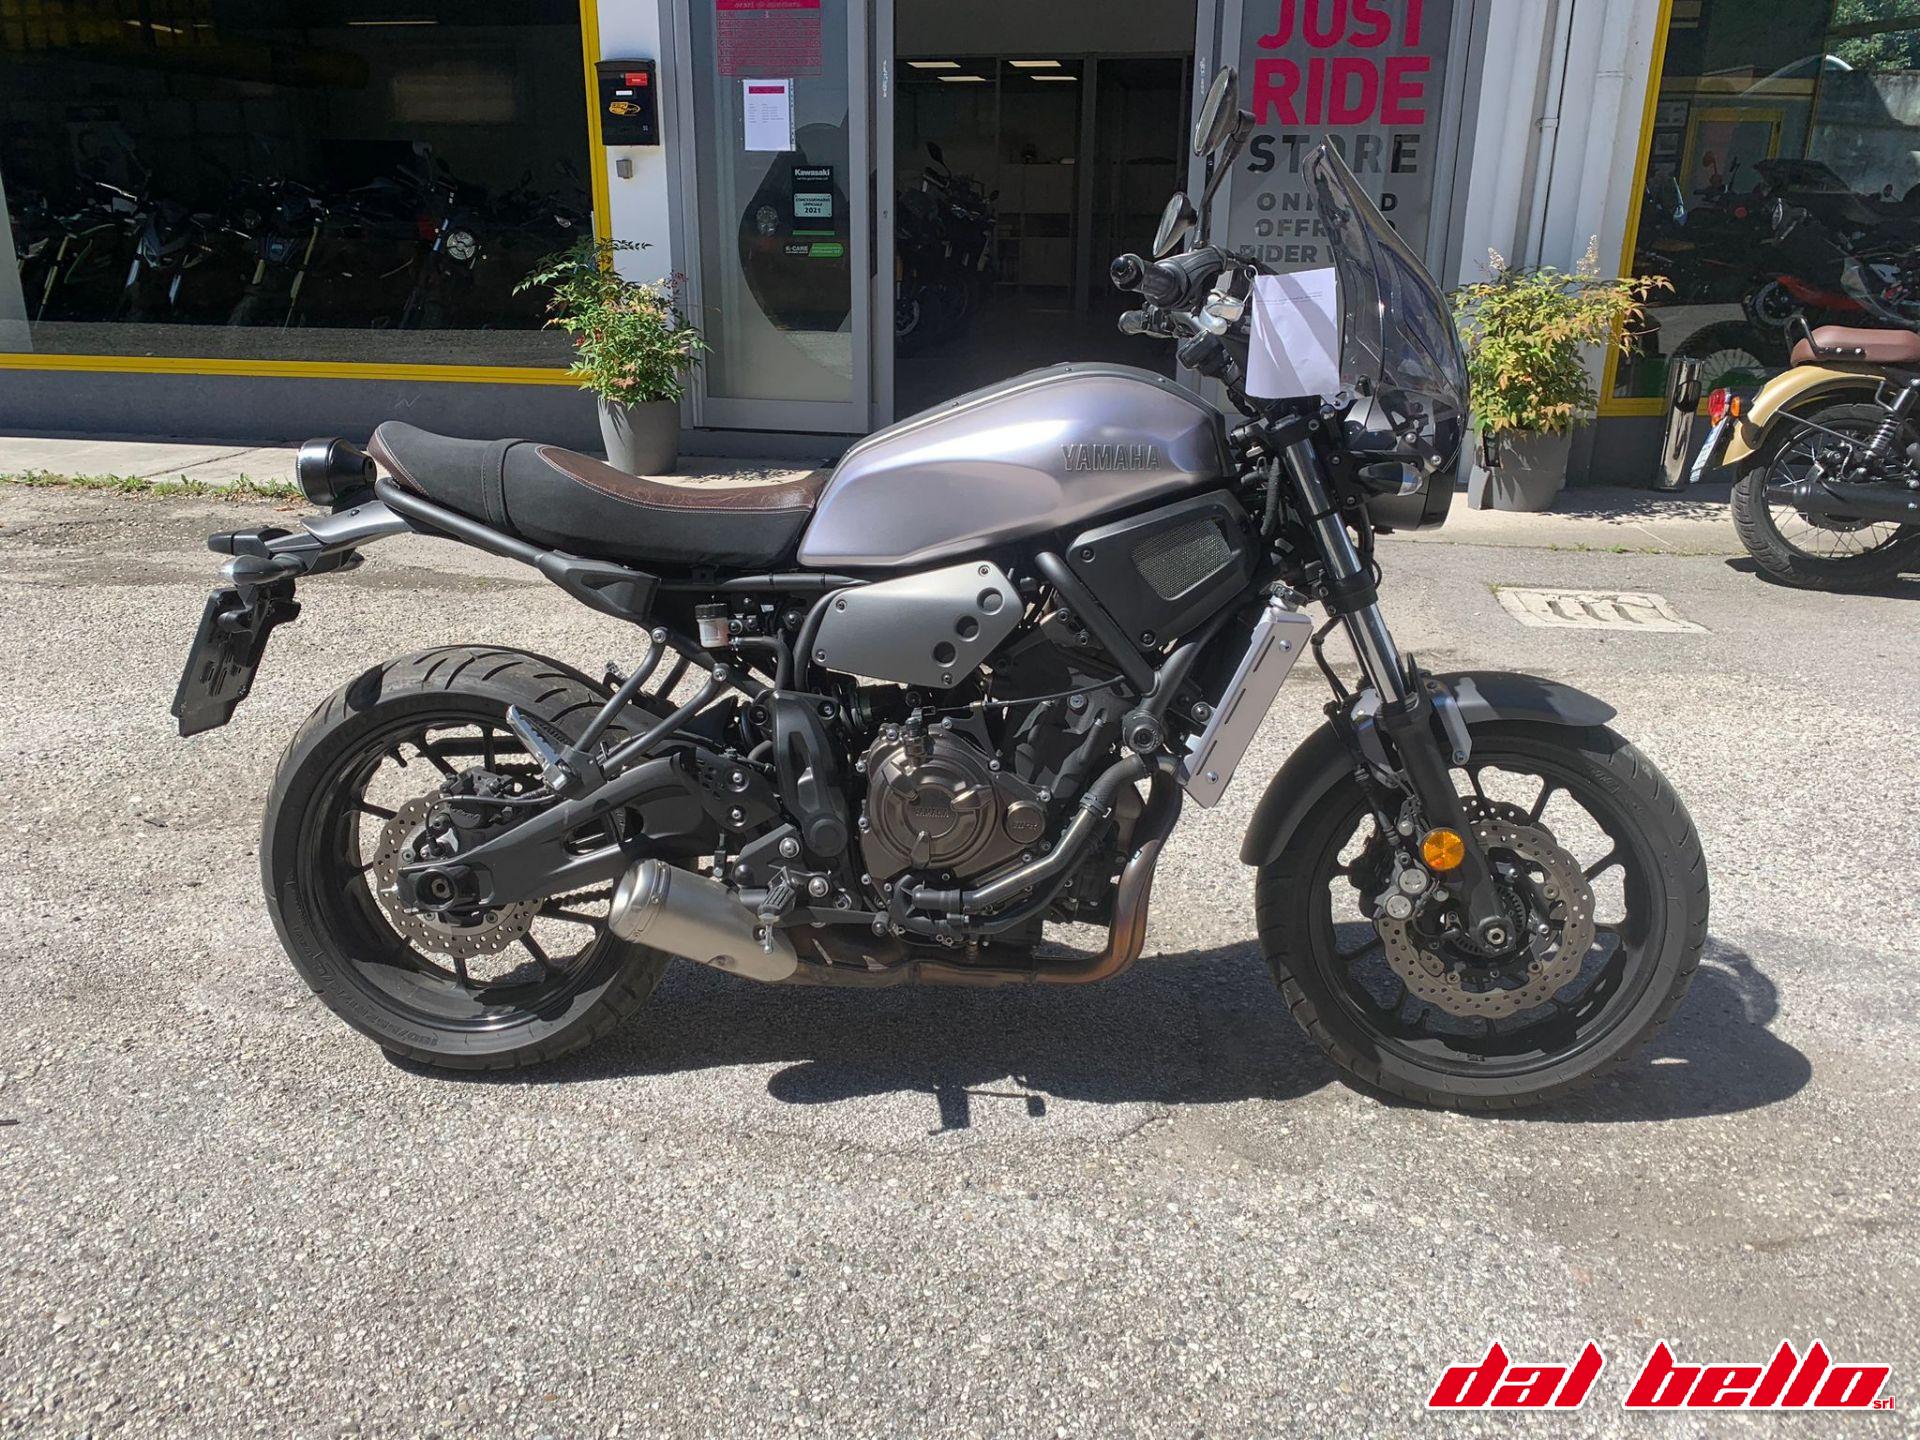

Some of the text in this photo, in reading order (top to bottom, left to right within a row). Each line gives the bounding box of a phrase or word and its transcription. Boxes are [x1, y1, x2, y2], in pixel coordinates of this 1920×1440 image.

[1256, 0, 1424, 49] JUST
[1252, 56, 1431, 126] RIDE
[1060, 443, 1161, 471] YAMAHA
